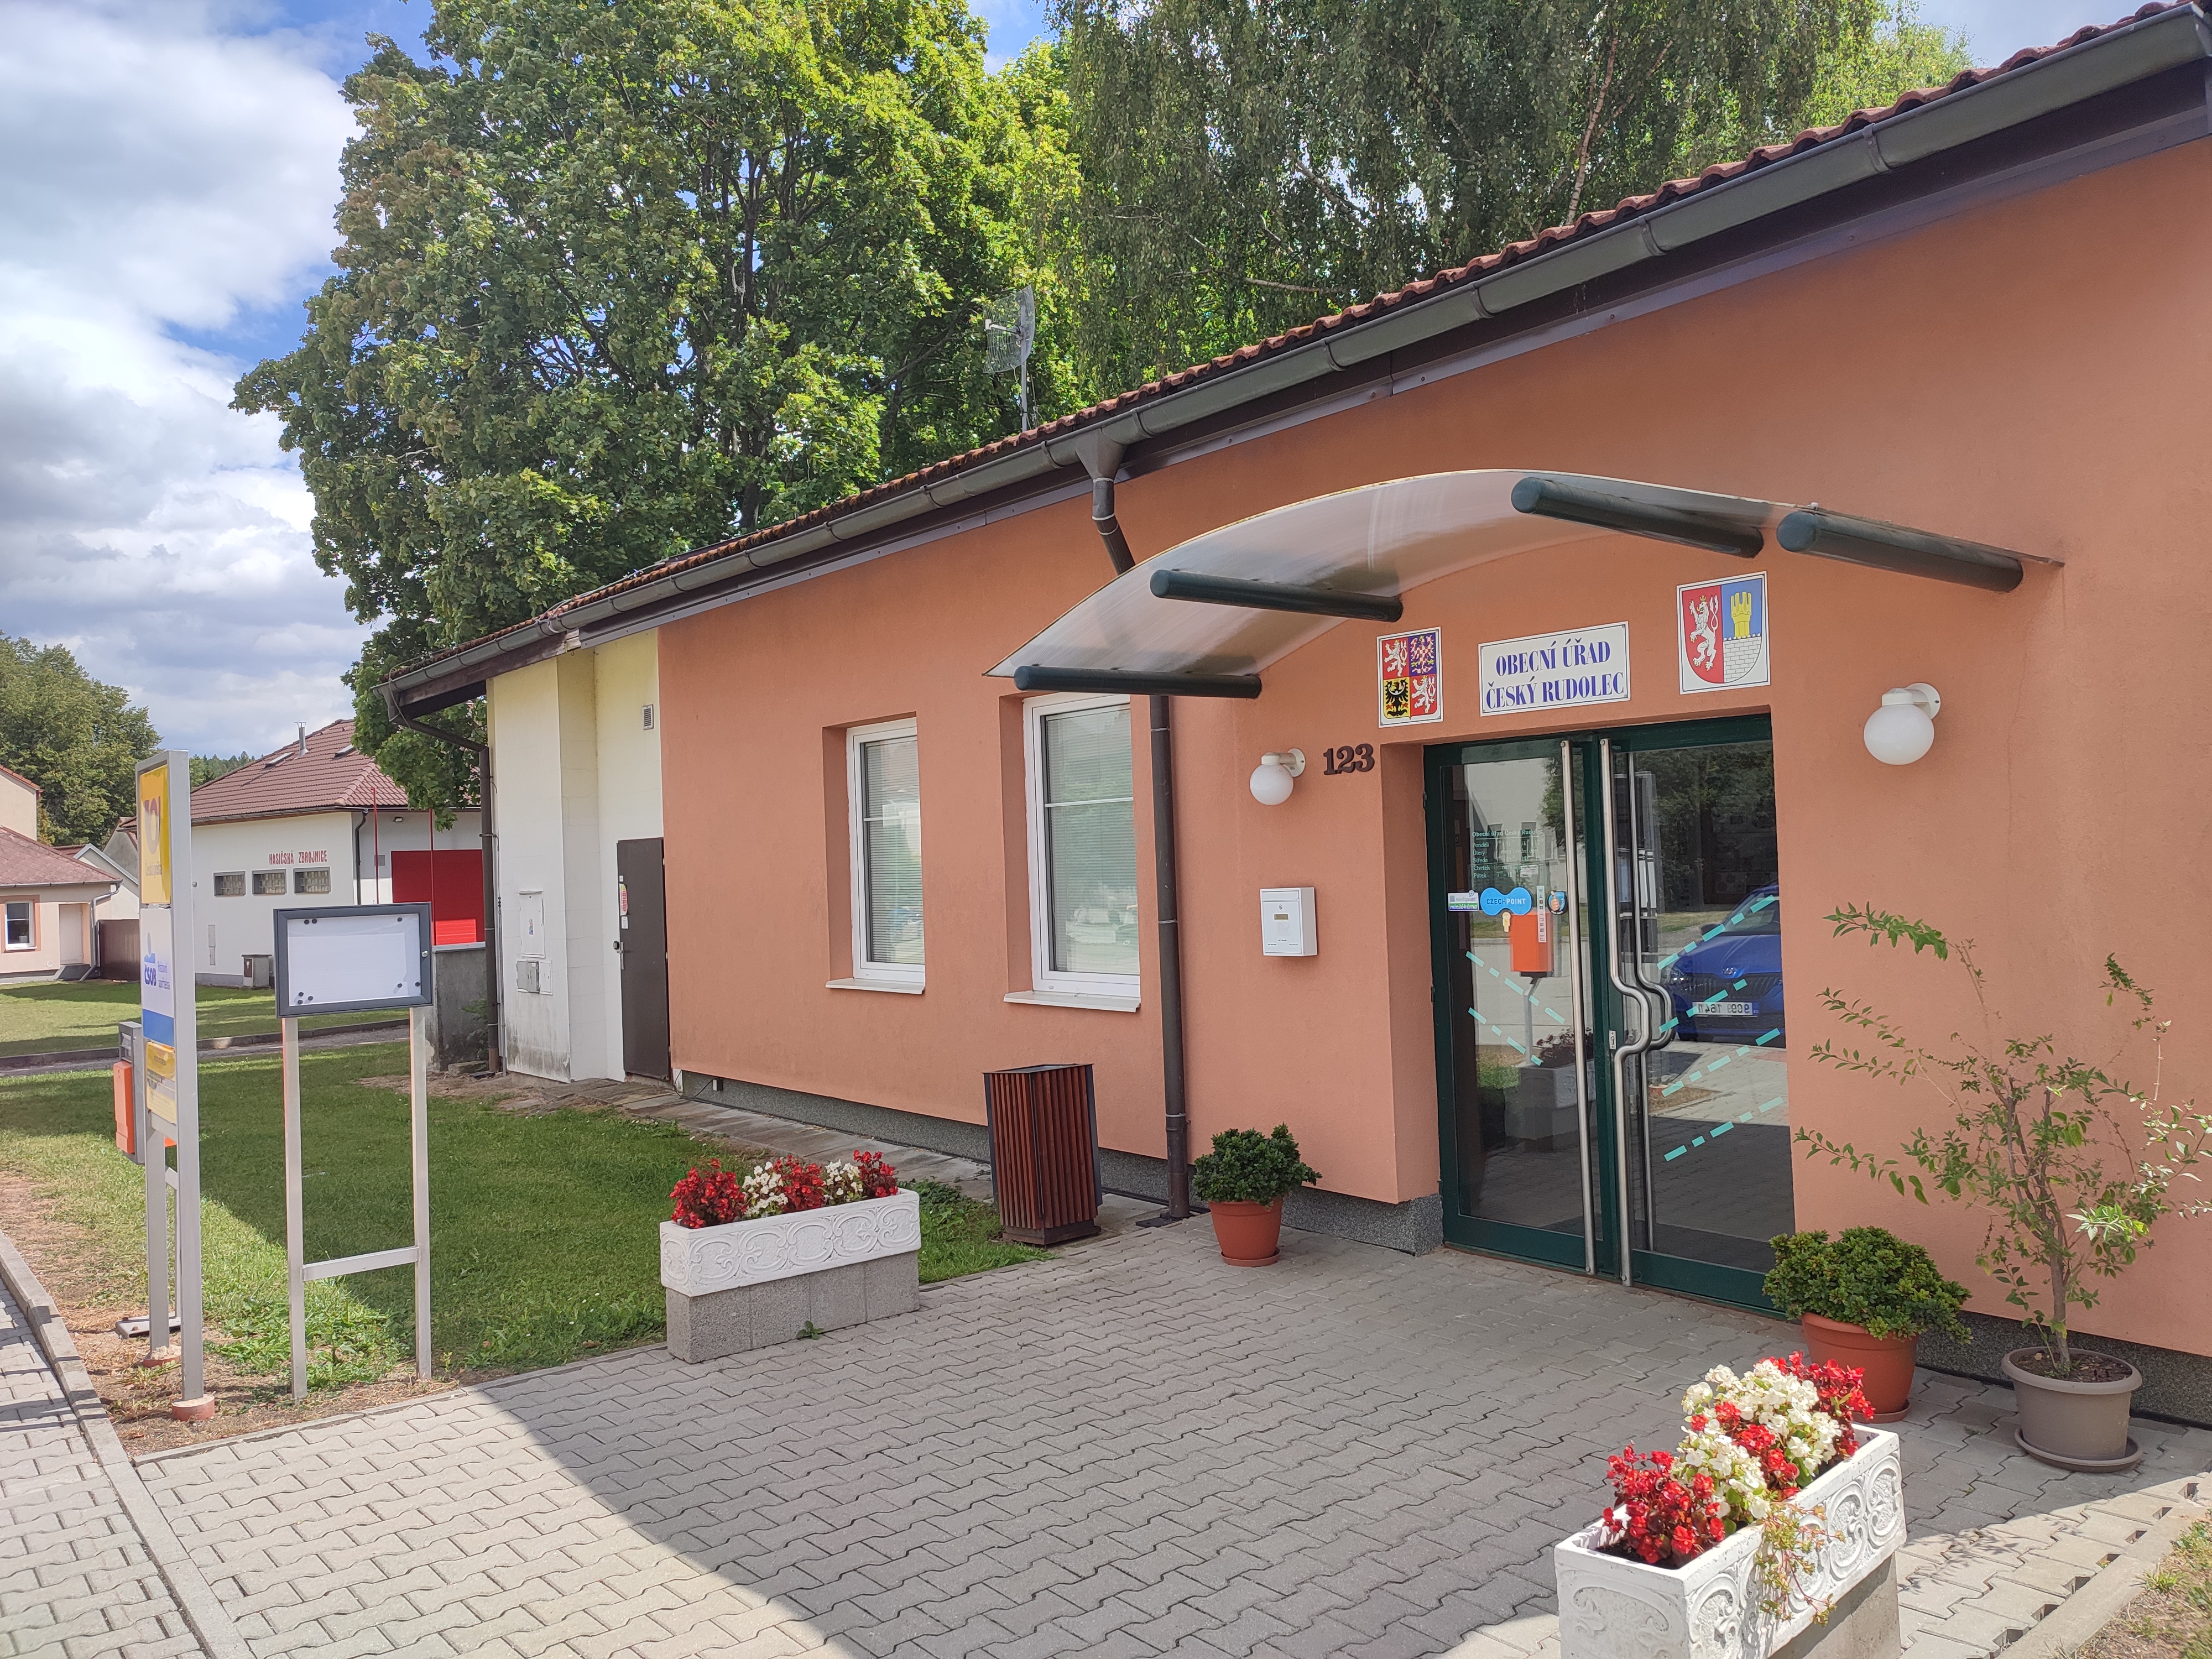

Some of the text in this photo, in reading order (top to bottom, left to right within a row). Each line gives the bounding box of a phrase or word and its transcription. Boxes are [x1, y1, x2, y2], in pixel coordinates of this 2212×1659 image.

[1496, 637, 1610, 677] OBECNÍ ÚŘAD
[1486, 672, 1624, 709] ČESKÝ RUDOLEC
[1323, 743, 1375, 775] 123
[269, 850, 327, 865] HASIČSKÁ ZBROJNICE
